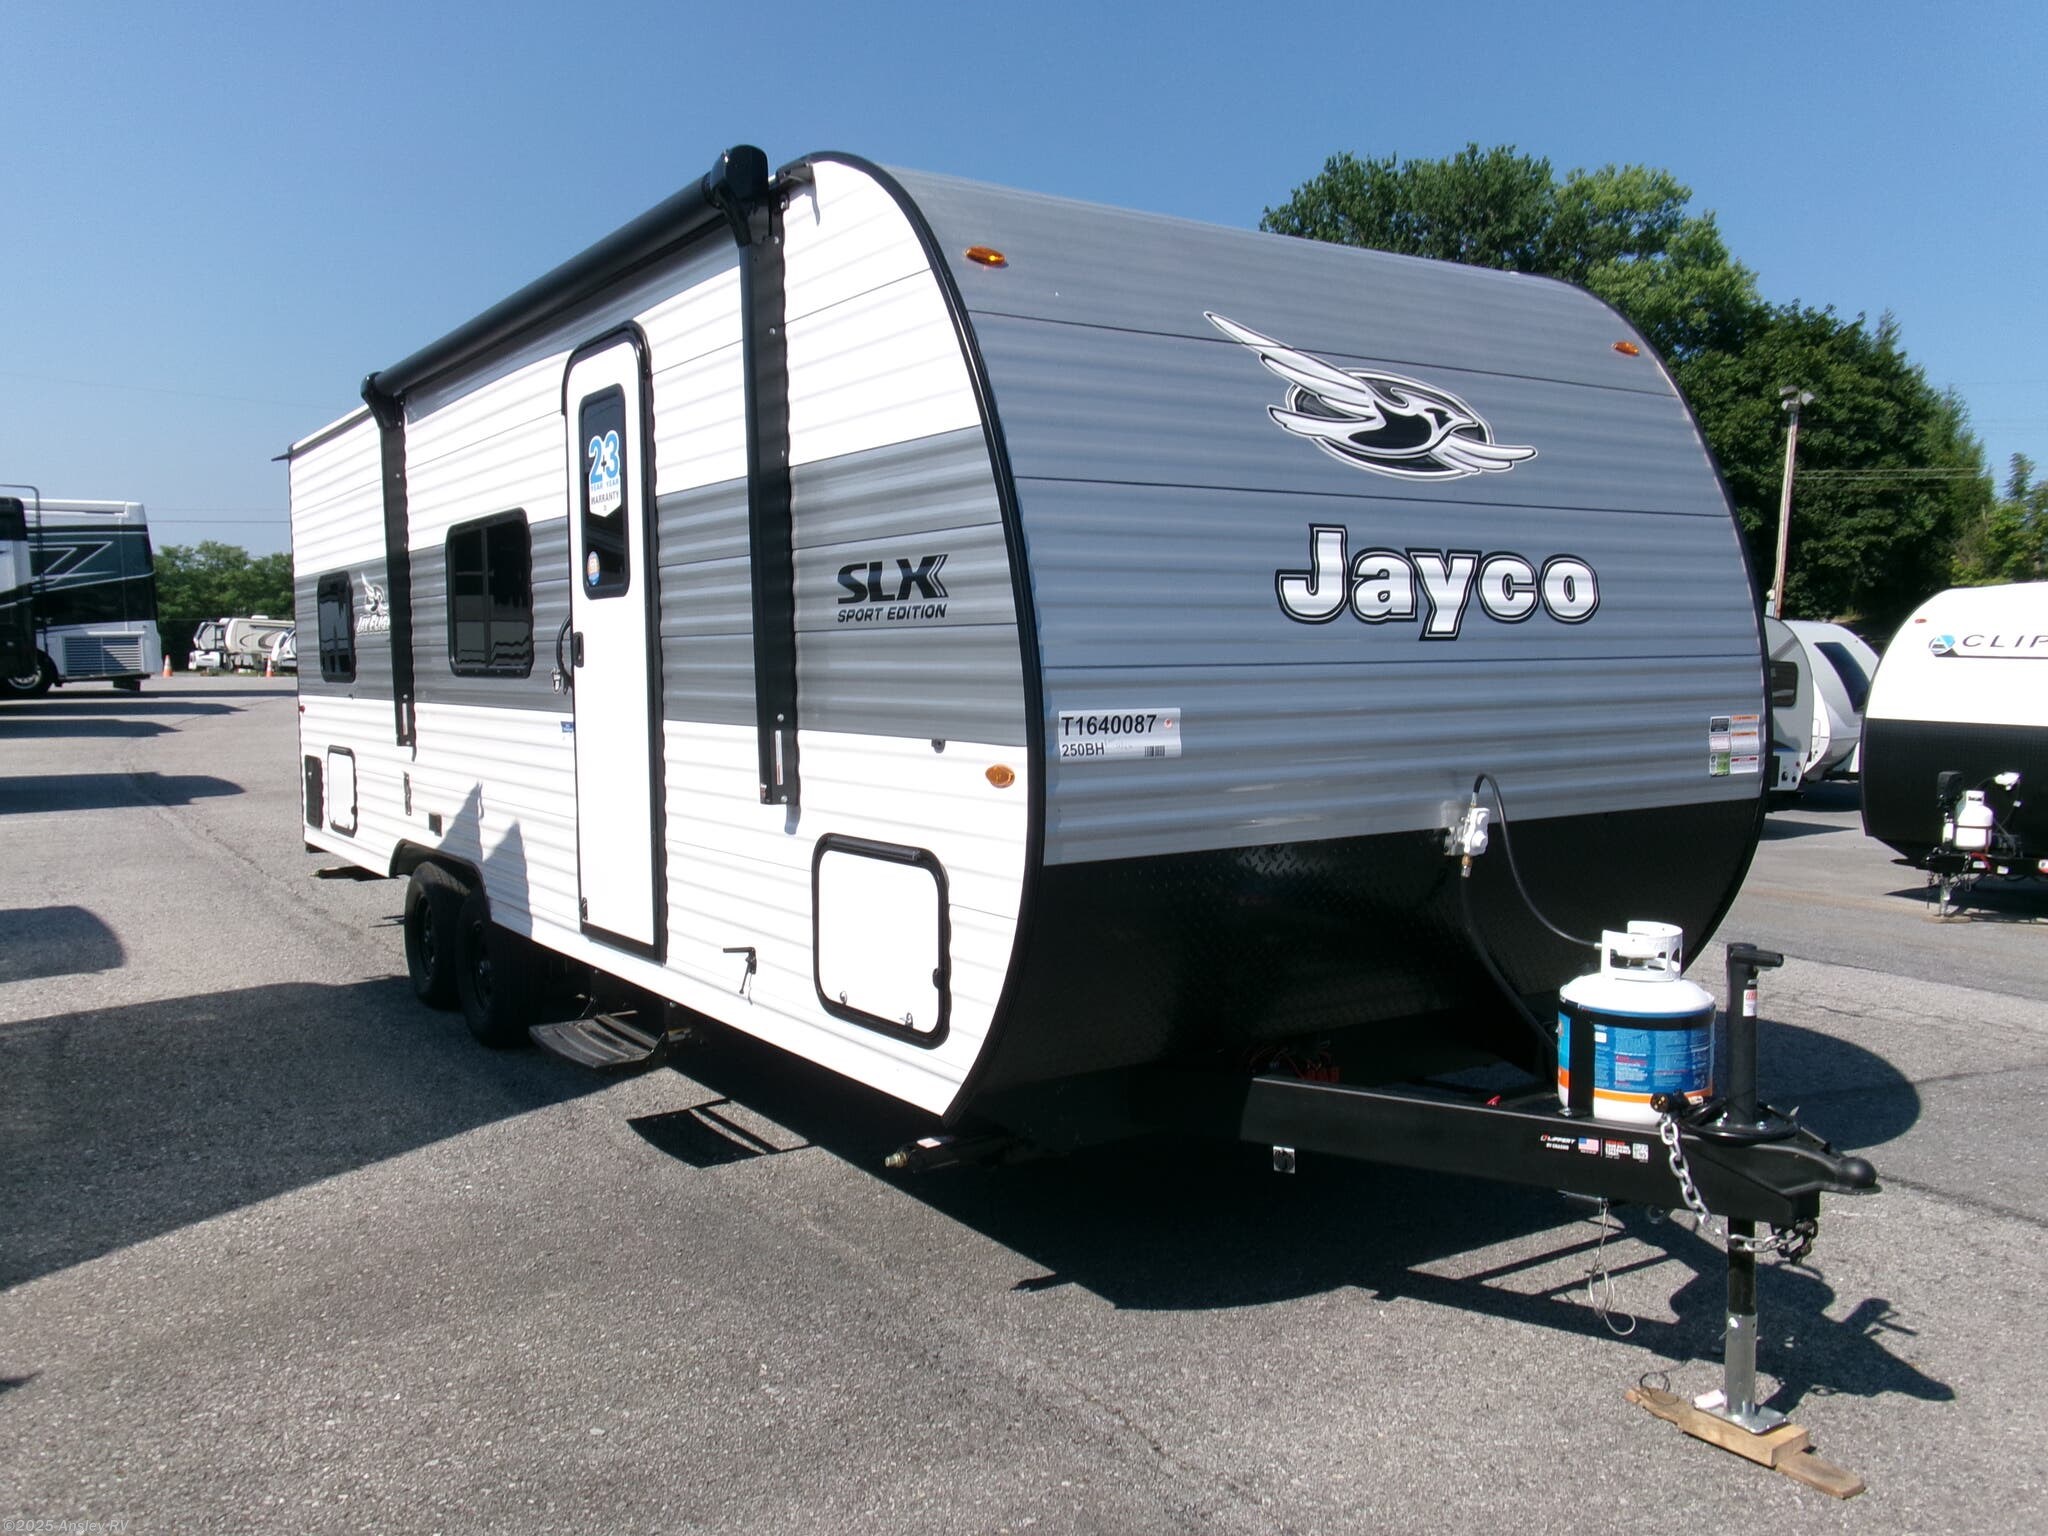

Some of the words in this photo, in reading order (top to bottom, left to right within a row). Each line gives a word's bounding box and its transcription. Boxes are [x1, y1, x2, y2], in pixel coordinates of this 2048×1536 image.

[591, 482, 603, 492] YEAR
[606, 478, 619, 488] YEAR
[591, 490, 619, 505] WARRANTY
[838, 554, 949, 604] SLX
[1274, 523, 1600, 641] Jayco
[837, 606, 884, 623] SPORT
[887, 603, 947, 621] EDITION
[1061, 714, 1158, 736] T1640087
[1062, 742, 1105, 757] 250BH
